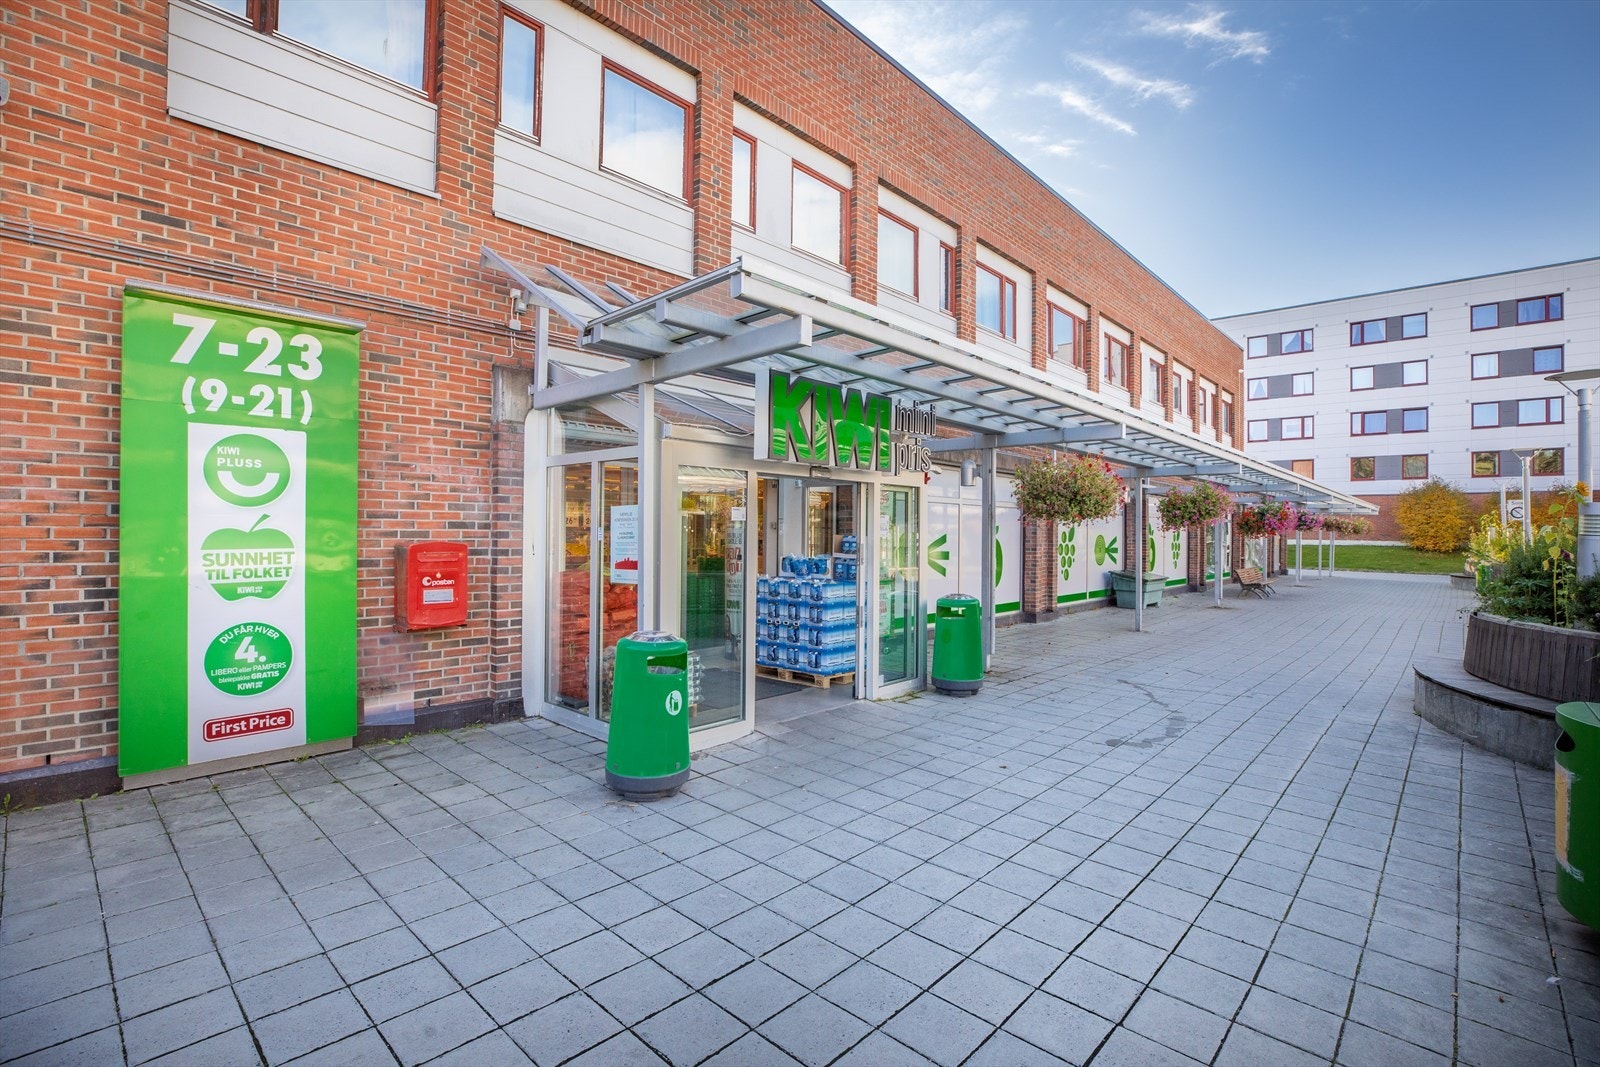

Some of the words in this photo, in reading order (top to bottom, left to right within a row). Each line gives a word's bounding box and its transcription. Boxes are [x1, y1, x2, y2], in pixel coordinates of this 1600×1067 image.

[181, 376, 313, 426] (9-21)
[768, 367, 893, 473] KIWI
[895, 399, 937, 437] mini
[217, 446, 240, 455] KIWI
[896, 437, 933, 477] pris
[216, 457, 262, 468] PLUSS
[202, 551, 295, 567] SUNNHET
[205, 569, 230, 580] TIL
[233, 566, 293, 579] FOLKET
[431, 578, 455, 586] posten
[237, 586, 255, 594] KIWI
[219, 631, 234, 644] DU
[233, 625, 253, 636] FÅR
[254, 625, 280, 640] HVER
[234, 636, 267, 663] 4.
[211, 667, 238, 676] LIBERO
[253, 662, 287, 671] PAMPERS
[251, 670, 280, 680] GRATIS
[237, 682, 255, 690] KIWI
[211, 721, 247, 736] First
[249, 715, 286, 730] Price
